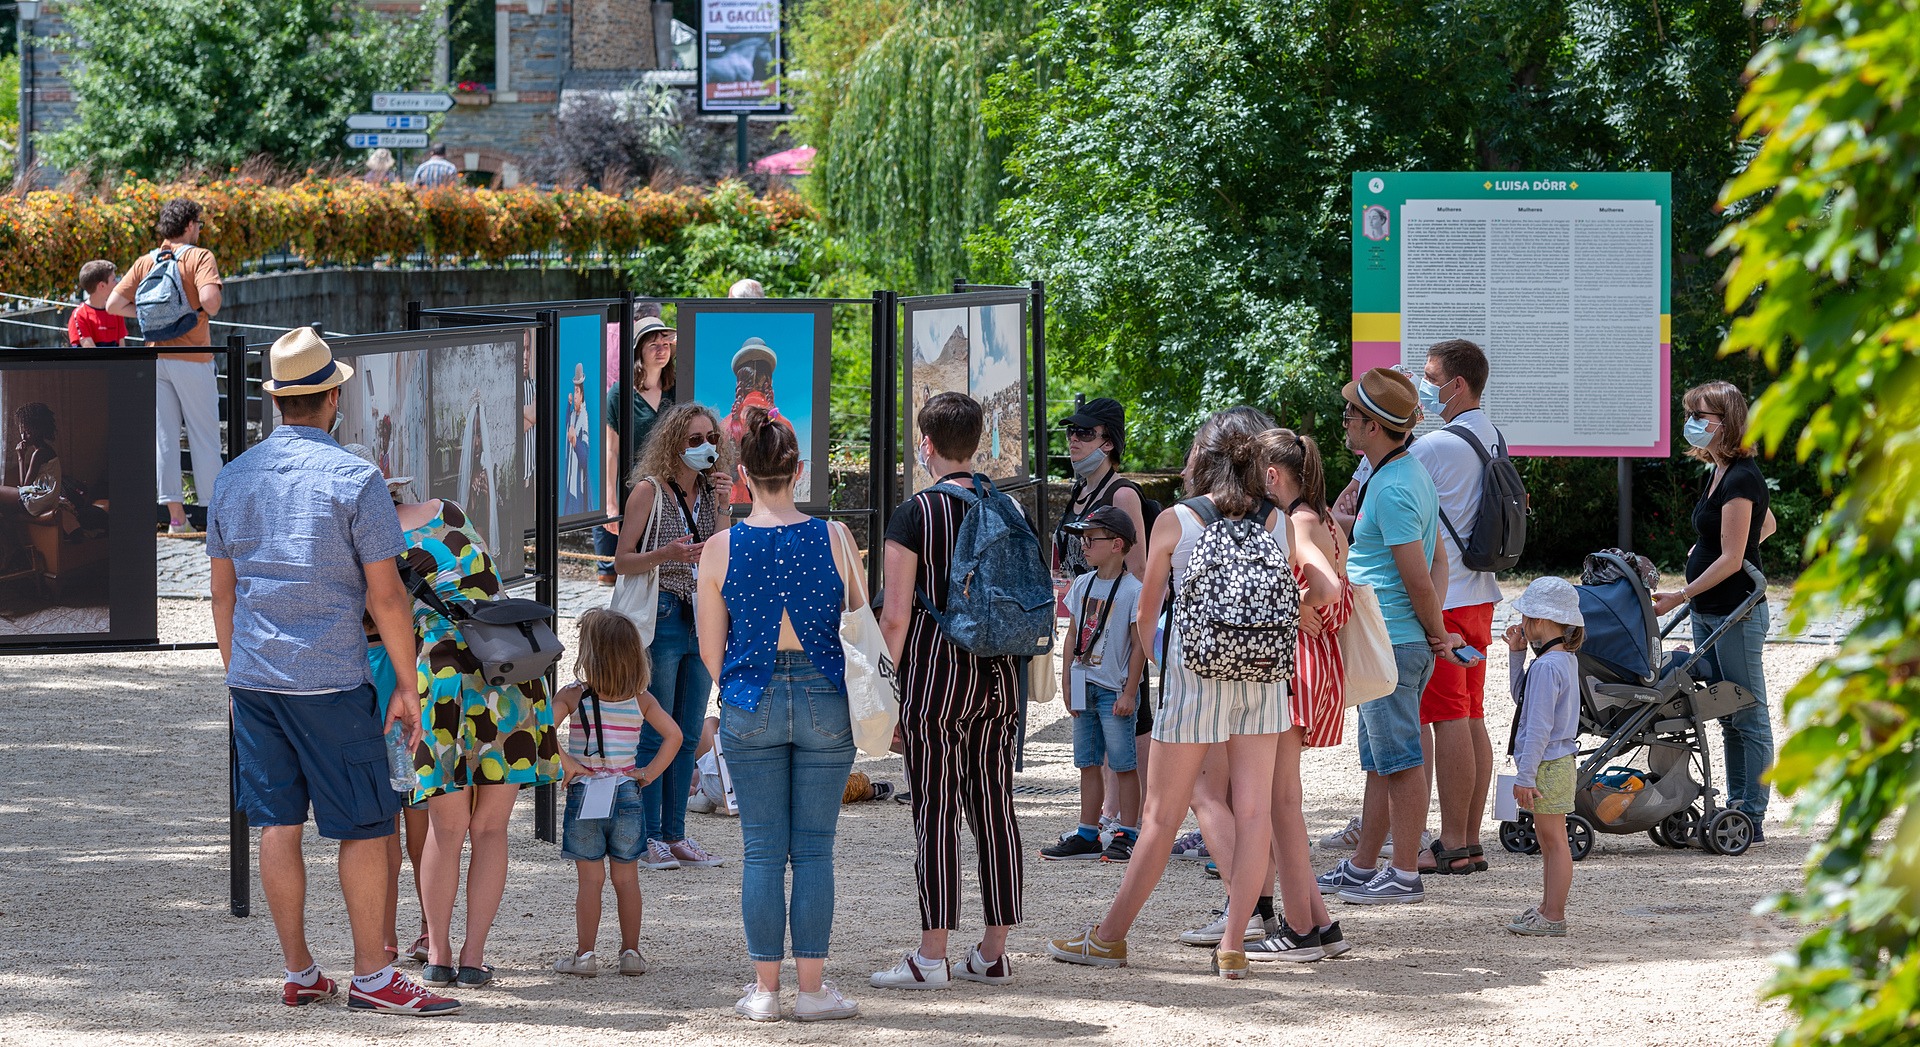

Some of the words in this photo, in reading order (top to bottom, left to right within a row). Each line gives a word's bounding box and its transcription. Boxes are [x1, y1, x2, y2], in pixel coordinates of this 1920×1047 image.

[709, 10, 723, 23] LA
[390, 97, 419, 106] Centre
[423, 97, 444, 106] Ville
[1495, 181, 1529, 191] LUISA
[1533, 179, 1567, 191] DÖRR
[301, 965, 317, 978] HEA
[355, 972, 383, 983] HEAD
